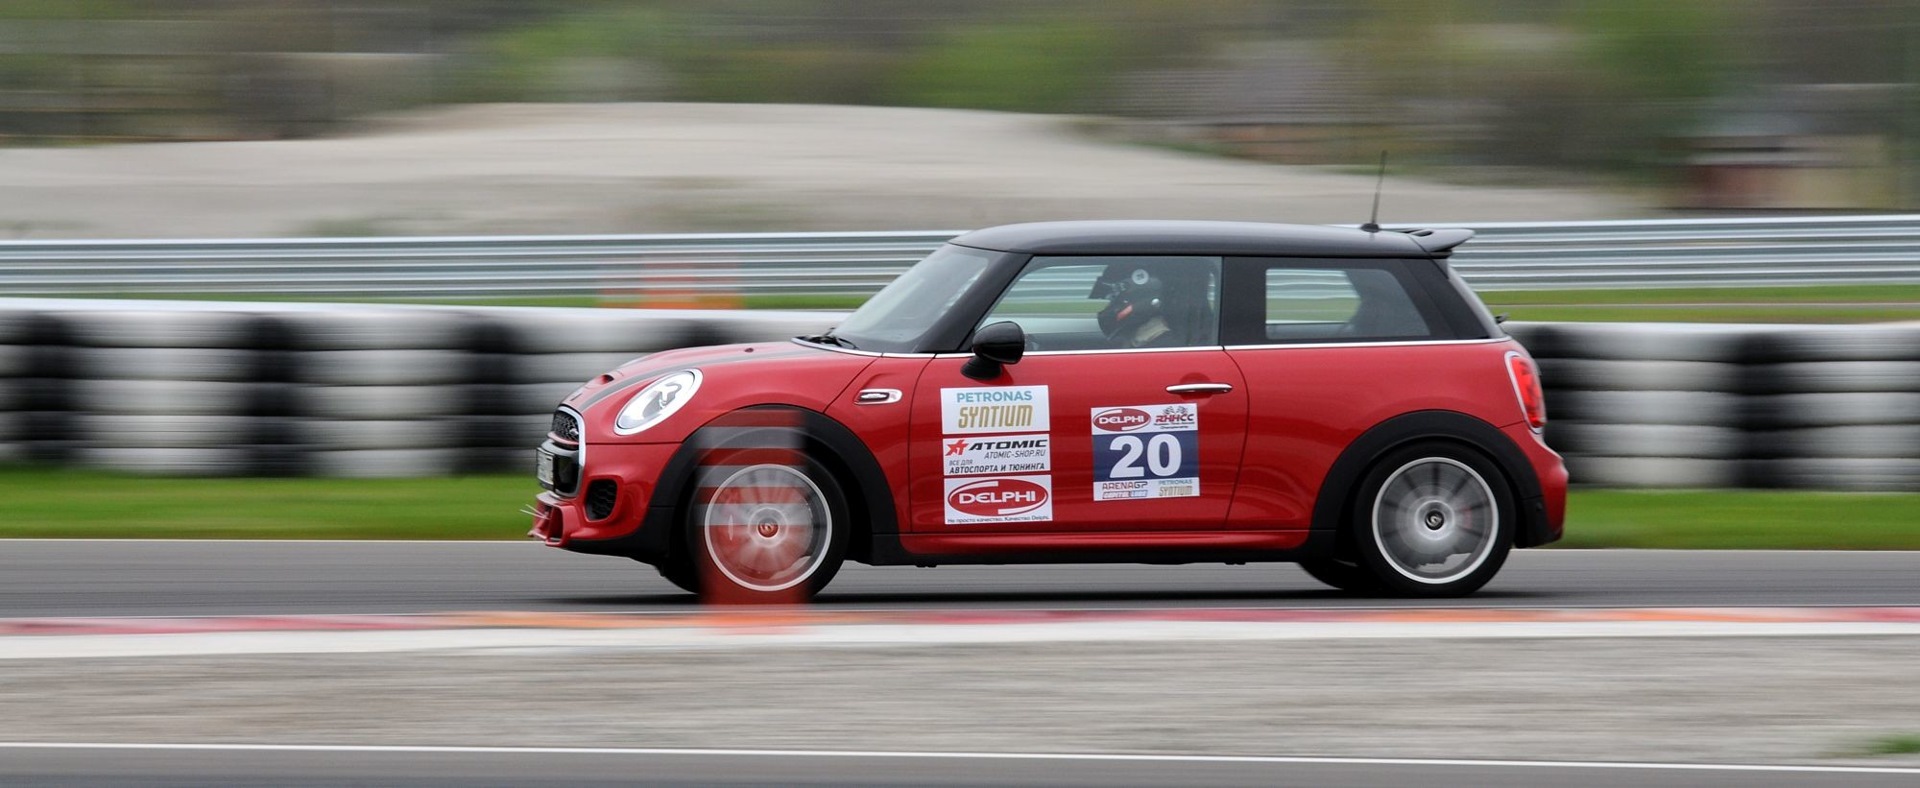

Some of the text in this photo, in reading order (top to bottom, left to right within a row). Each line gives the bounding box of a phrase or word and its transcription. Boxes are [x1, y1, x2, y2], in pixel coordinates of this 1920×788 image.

[956, 390, 1034, 403] PETRONAS
[958, 404, 1034, 429] SYNTIUM
[1099, 415, 1145, 425] DELPHI
[1155, 413, 1195, 423] RHHCC
[968, 439, 1048, 451] ATOMIC
[984, 449, 1047, 460] ATOMIC-SHOP.RU
[1109, 433, 1182, 479] 20
[949, 462, 1045, 474] АВТОСПОРТА И ТЮНИНГА
[958, 490, 1036, 505] DELPHI
